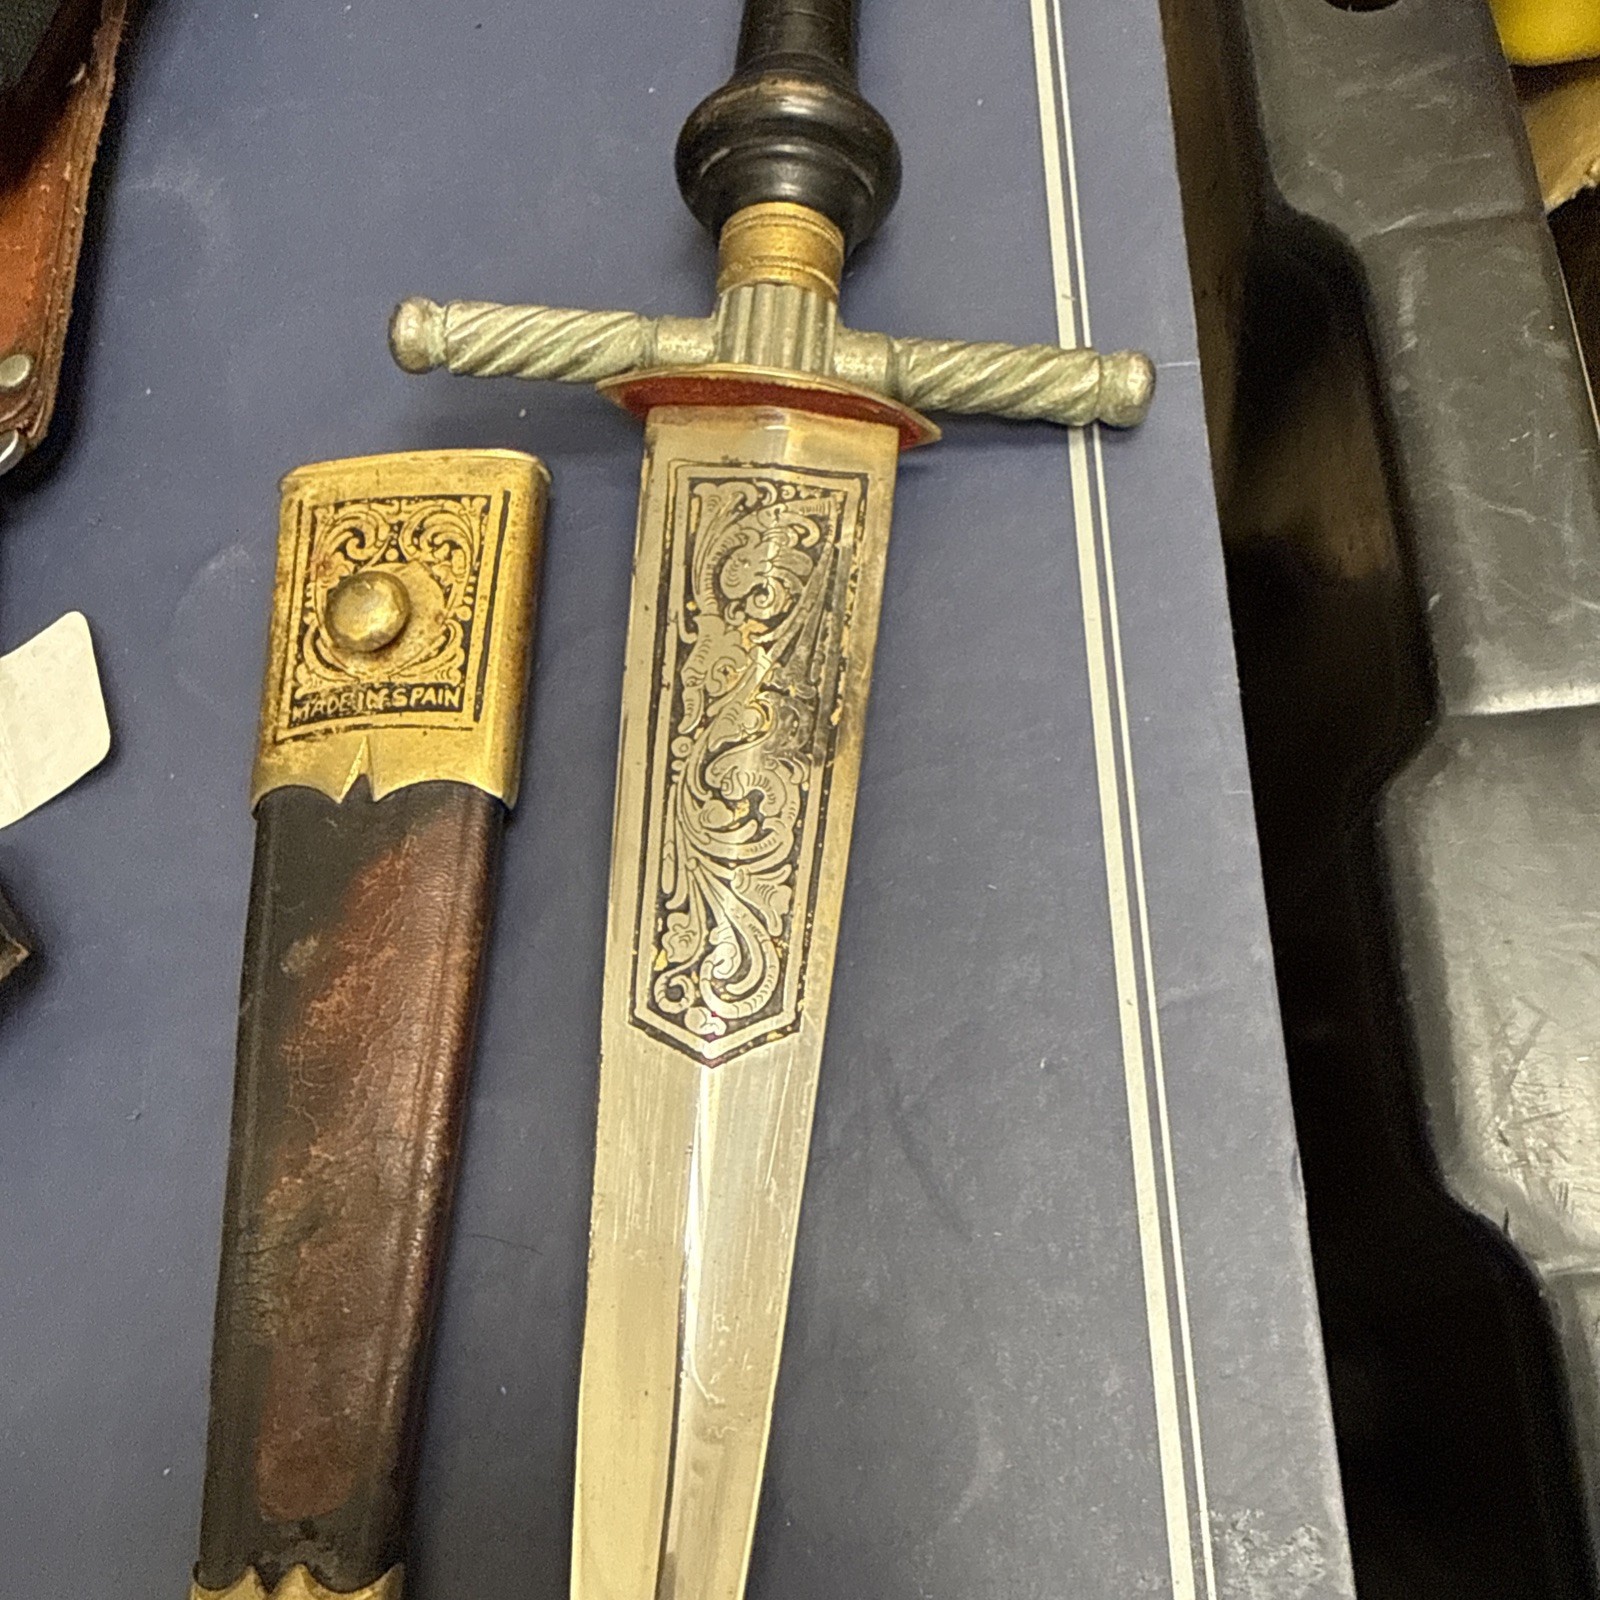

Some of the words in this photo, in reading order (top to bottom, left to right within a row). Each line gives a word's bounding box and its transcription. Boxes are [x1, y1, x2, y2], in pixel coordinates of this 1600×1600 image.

[292, 692, 349, 722] MADE
[357, 688, 385, 712] IN
[392, 686, 461, 708] SPAIN
